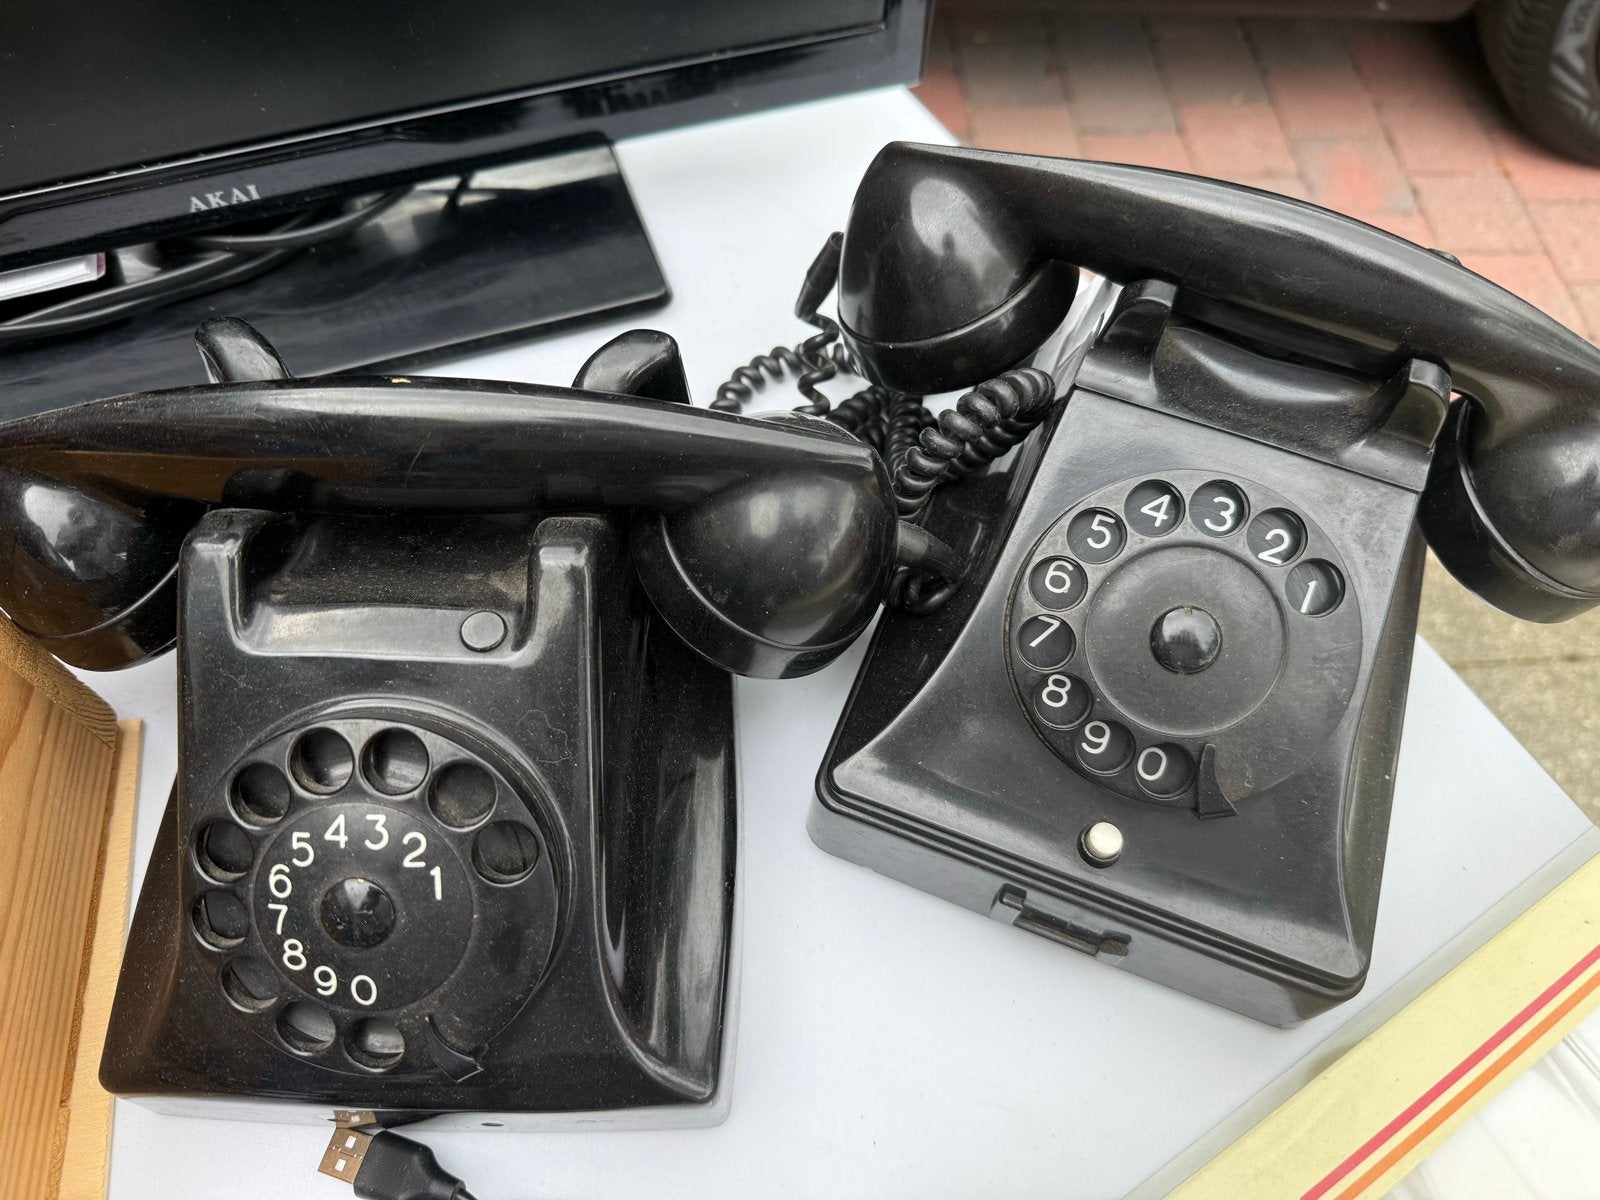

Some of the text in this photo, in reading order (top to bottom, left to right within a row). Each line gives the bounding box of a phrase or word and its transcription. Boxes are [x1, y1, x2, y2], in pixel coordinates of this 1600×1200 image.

[190, 184, 262, 213] AKAI
[1140, 494, 1171, 527] 4
[1204, 496, 1236, 531] 3
[1087, 514, 1116, 549] 5
[1257, 528, 1291, 564] 2
[1044, 560, 1074, 593] 6
[1300, 580, 1317, 613] 1
[1029, 615, 1061, 647] 7
[1041, 674, 1071, 708] 8
[1081, 720, 1111, 754] 9
[1137, 747, 1167, 781] 0
[324, 814, 348, 849] 4
[365, 814, 389, 850] 3
[292, 832, 314, 867] 5
[402, 832, 427, 868] 2
[269, 864, 292, 898] 6
[430, 865, 443, 900] 1
[268, 903, 288, 935] 7
[283, 939, 307, 970] 8
[313, 966, 337, 996] 9
[351, 975, 377, 1005] 0
